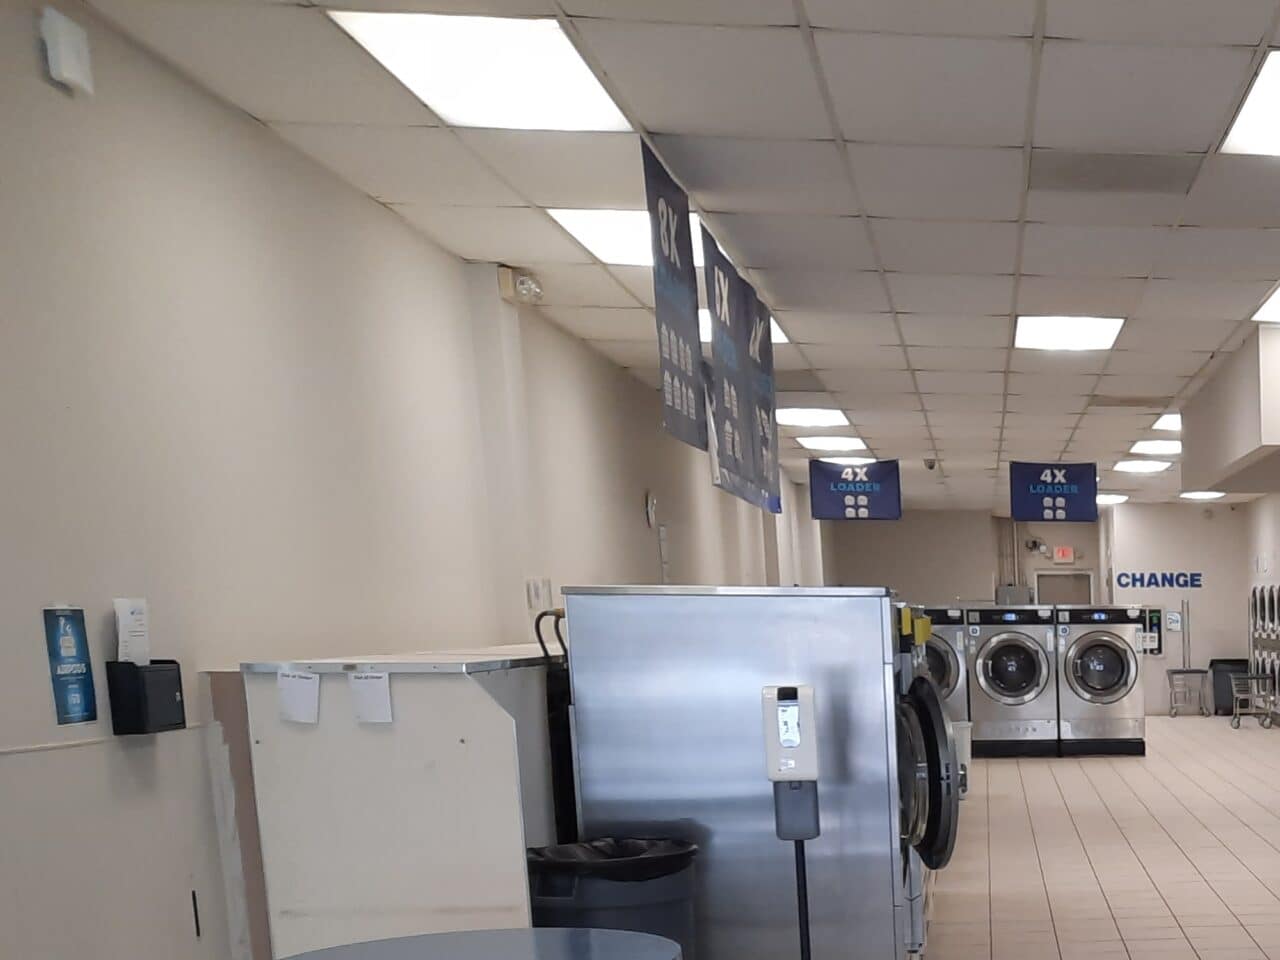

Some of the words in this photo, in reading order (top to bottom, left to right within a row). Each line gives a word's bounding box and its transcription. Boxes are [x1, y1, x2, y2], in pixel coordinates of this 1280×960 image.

[658, 197, 681, 269] 8X
[841, 466, 869, 482] 4X
[1040, 468, 1067, 484] 4X
[830, 482, 881, 492] LOADER
[1029, 484, 1078, 494] LOADER
[1116, 572, 1203, 588] CHANGE
